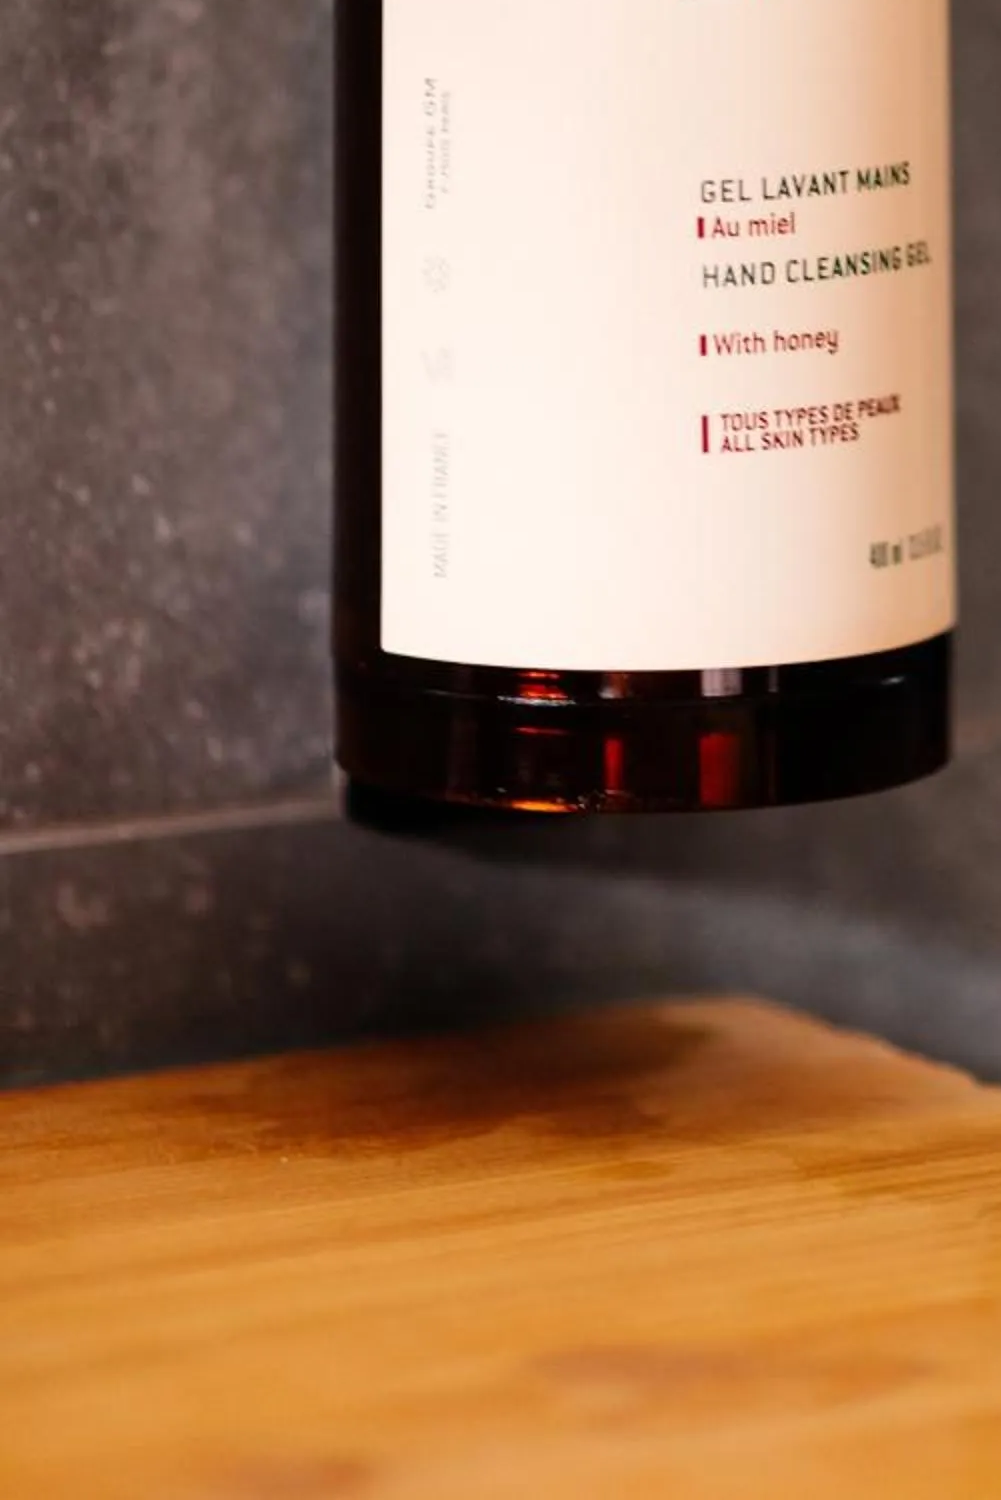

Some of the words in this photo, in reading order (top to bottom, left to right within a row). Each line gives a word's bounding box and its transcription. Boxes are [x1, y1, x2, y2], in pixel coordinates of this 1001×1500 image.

[701, 180, 752, 203] GEL
[762, 170, 850, 201] LAVANT
[857, 161, 910, 192] MAINS
[711, 216, 740, 239] Au
[748, 212, 796, 237] miel
[702, 261, 776, 289] HAND
[786, 246, 901, 284] CLEANSING
[712, 331, 766, 355] With
[774, 329, 839, 355] honey
[721, 411, 769, 432] TOUS
[774, 405, 828, 428] TYPES
[833, 401, 854, 423] DE
[721, 435, 755, 453] ALL
[761, 429, 804, 451] SKIN
[809, 422, 861, 447] TYPES
